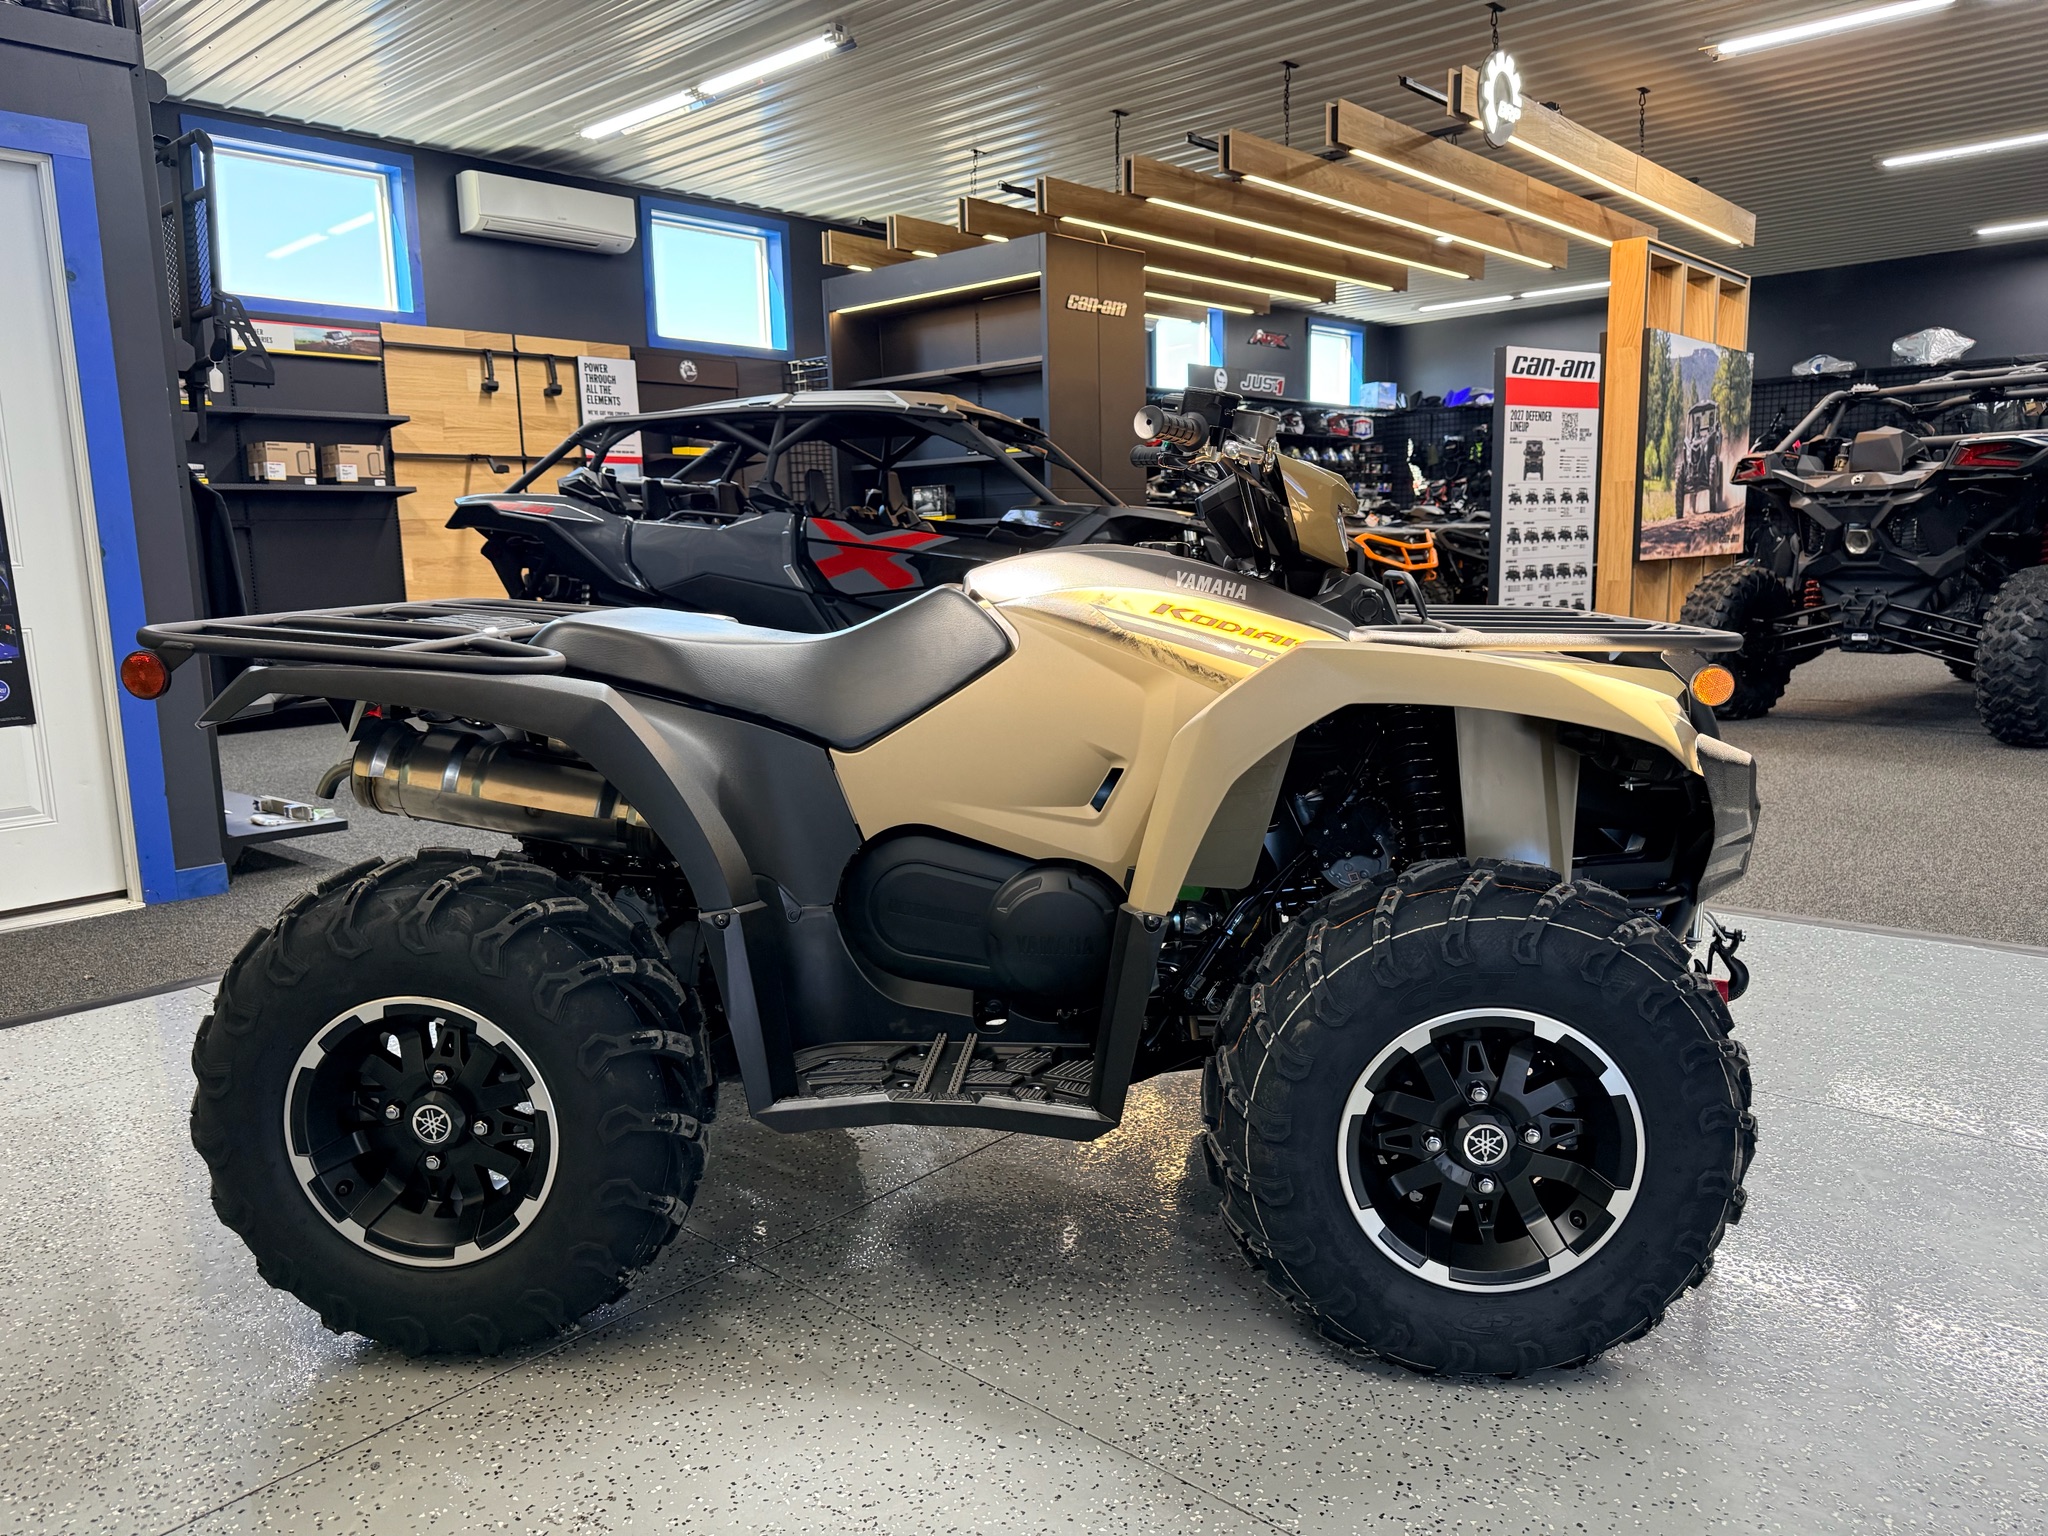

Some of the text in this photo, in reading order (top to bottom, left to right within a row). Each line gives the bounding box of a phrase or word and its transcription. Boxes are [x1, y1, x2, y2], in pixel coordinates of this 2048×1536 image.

[1067, 294, 1127, 317] can-am
[584, 362, 608, 374] POWER
[1511, 355, 1596, 379] can-am
[585, 373, 617, 385] THROUGH
[586, 384, 612, 395] ALL THE
[587, 395, 621, 406] ELEMENTS
[1525, 410, 1552, 422] DEFENDER
[1510, 421, 1529, 432] LINEUP
[1176, 570, 1247, 600] YAMAHA
